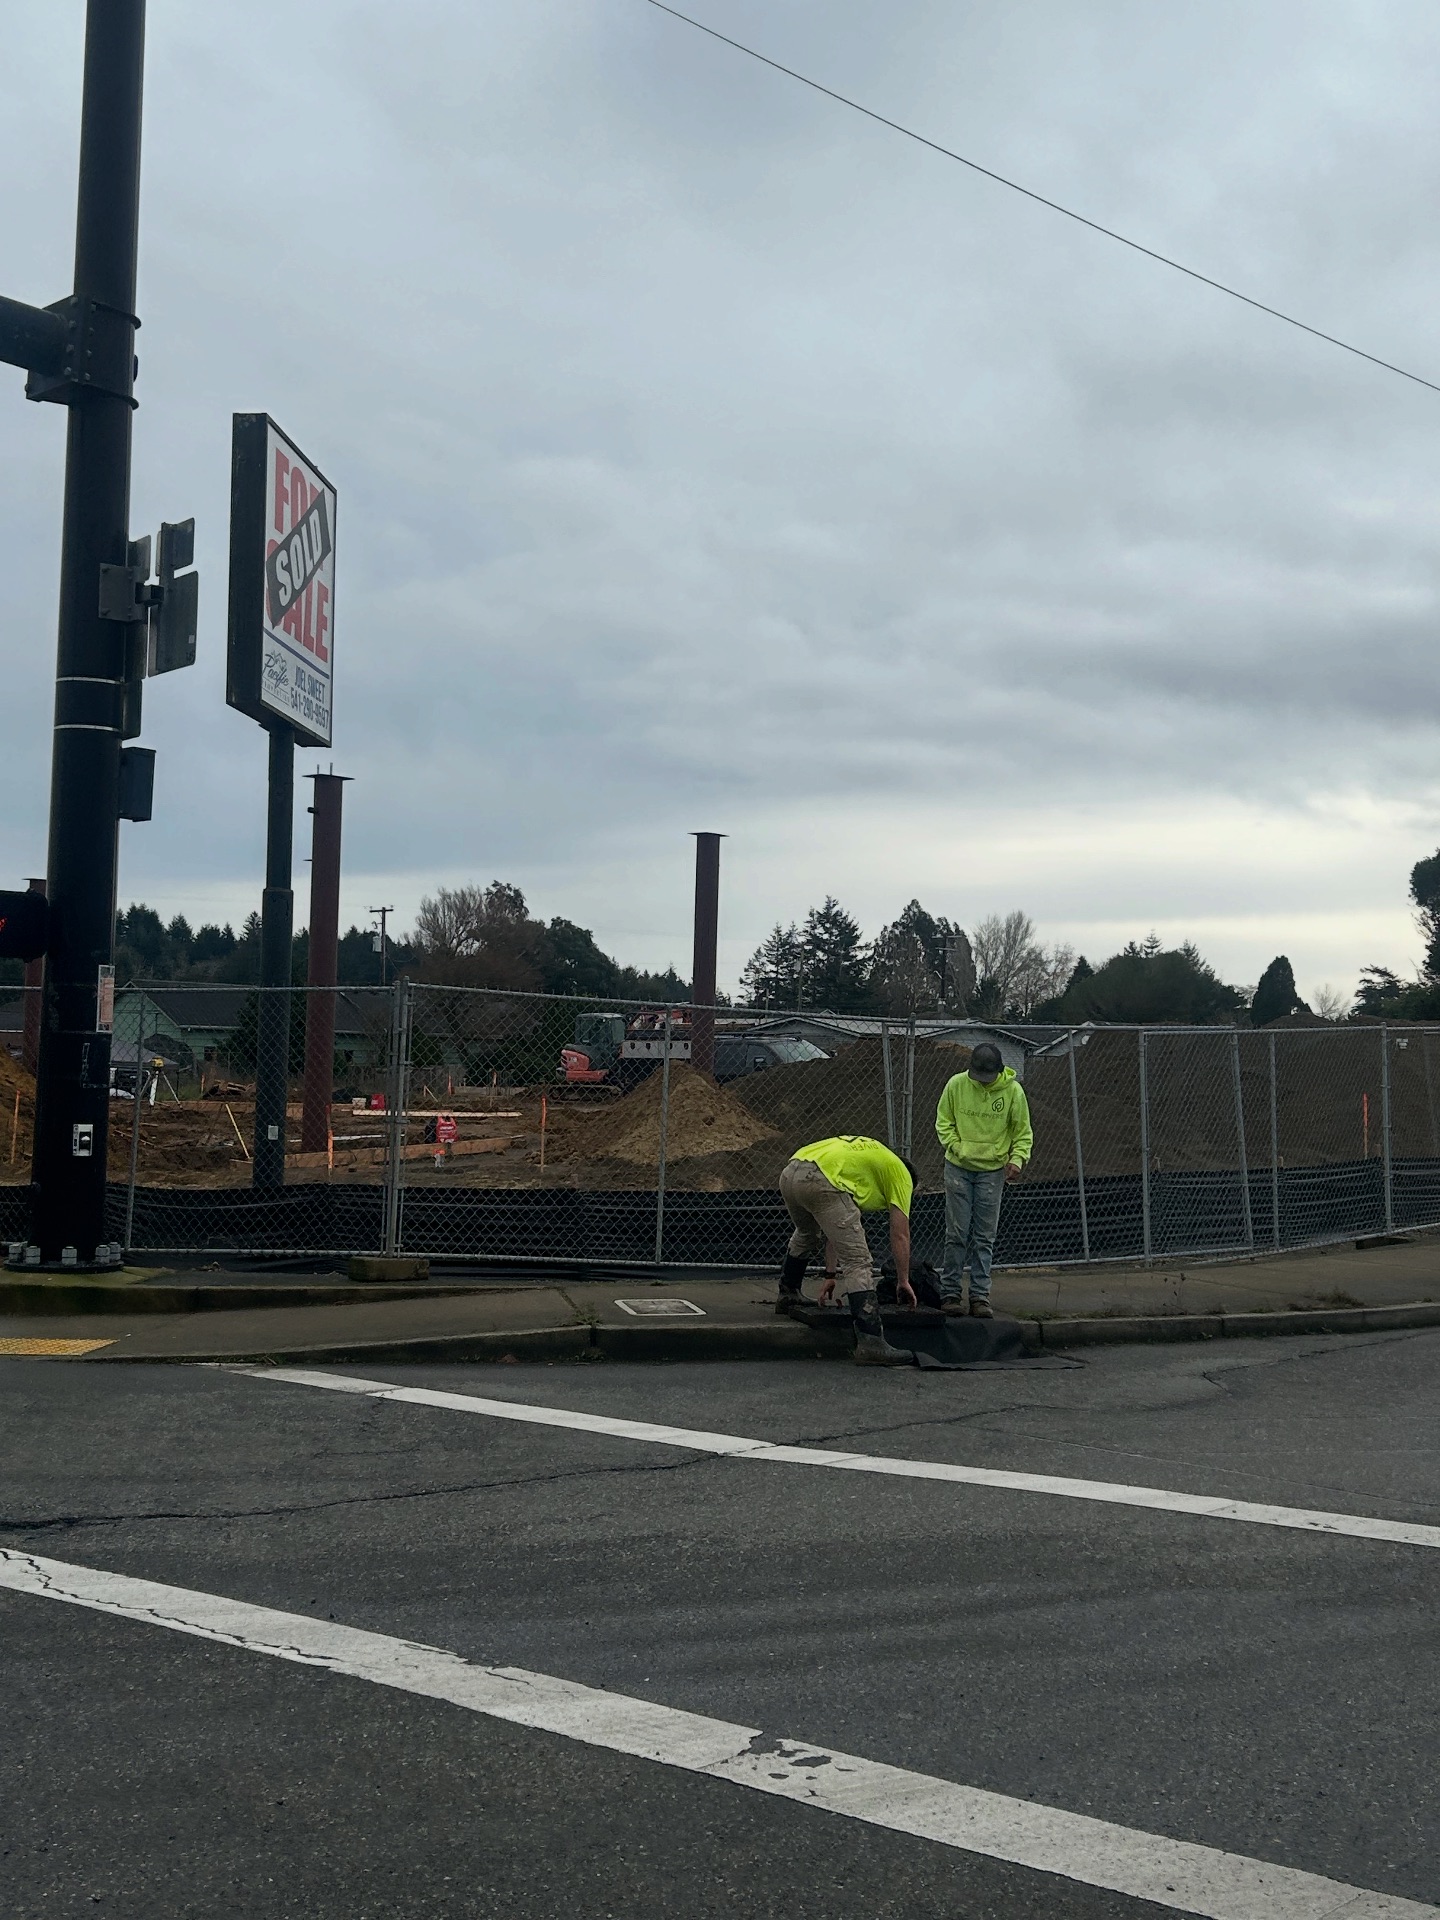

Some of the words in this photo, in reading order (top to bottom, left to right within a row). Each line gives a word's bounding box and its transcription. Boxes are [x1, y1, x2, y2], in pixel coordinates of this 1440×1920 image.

[275, 508, 323, 607] SOLD
[295, 666, 306, 693] JOEL
[308, 674, 326, 704] SWEET
